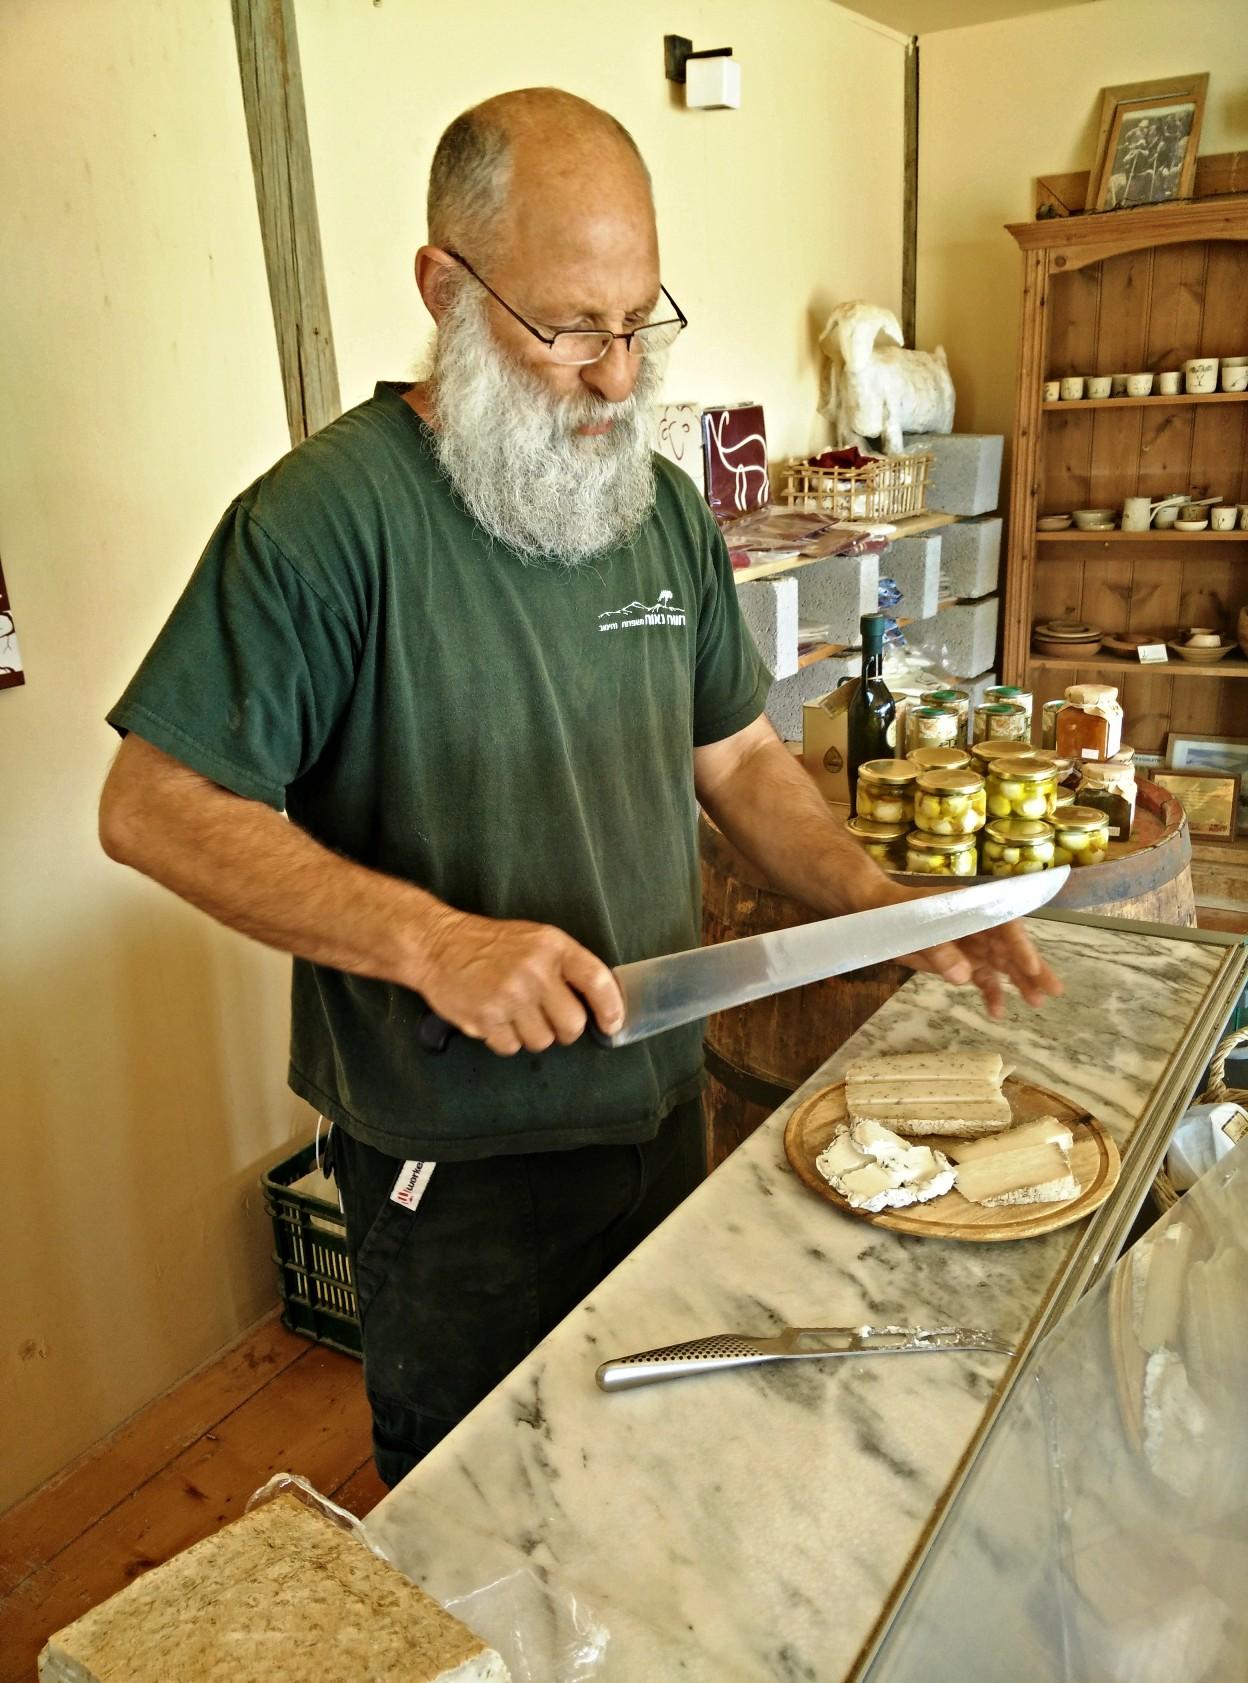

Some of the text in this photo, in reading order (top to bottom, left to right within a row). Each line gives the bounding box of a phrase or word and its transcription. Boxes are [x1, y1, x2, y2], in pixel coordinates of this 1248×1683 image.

[645, 613, 686, 626] חוות נאות
[406, 1160, 424, 1192] worke
